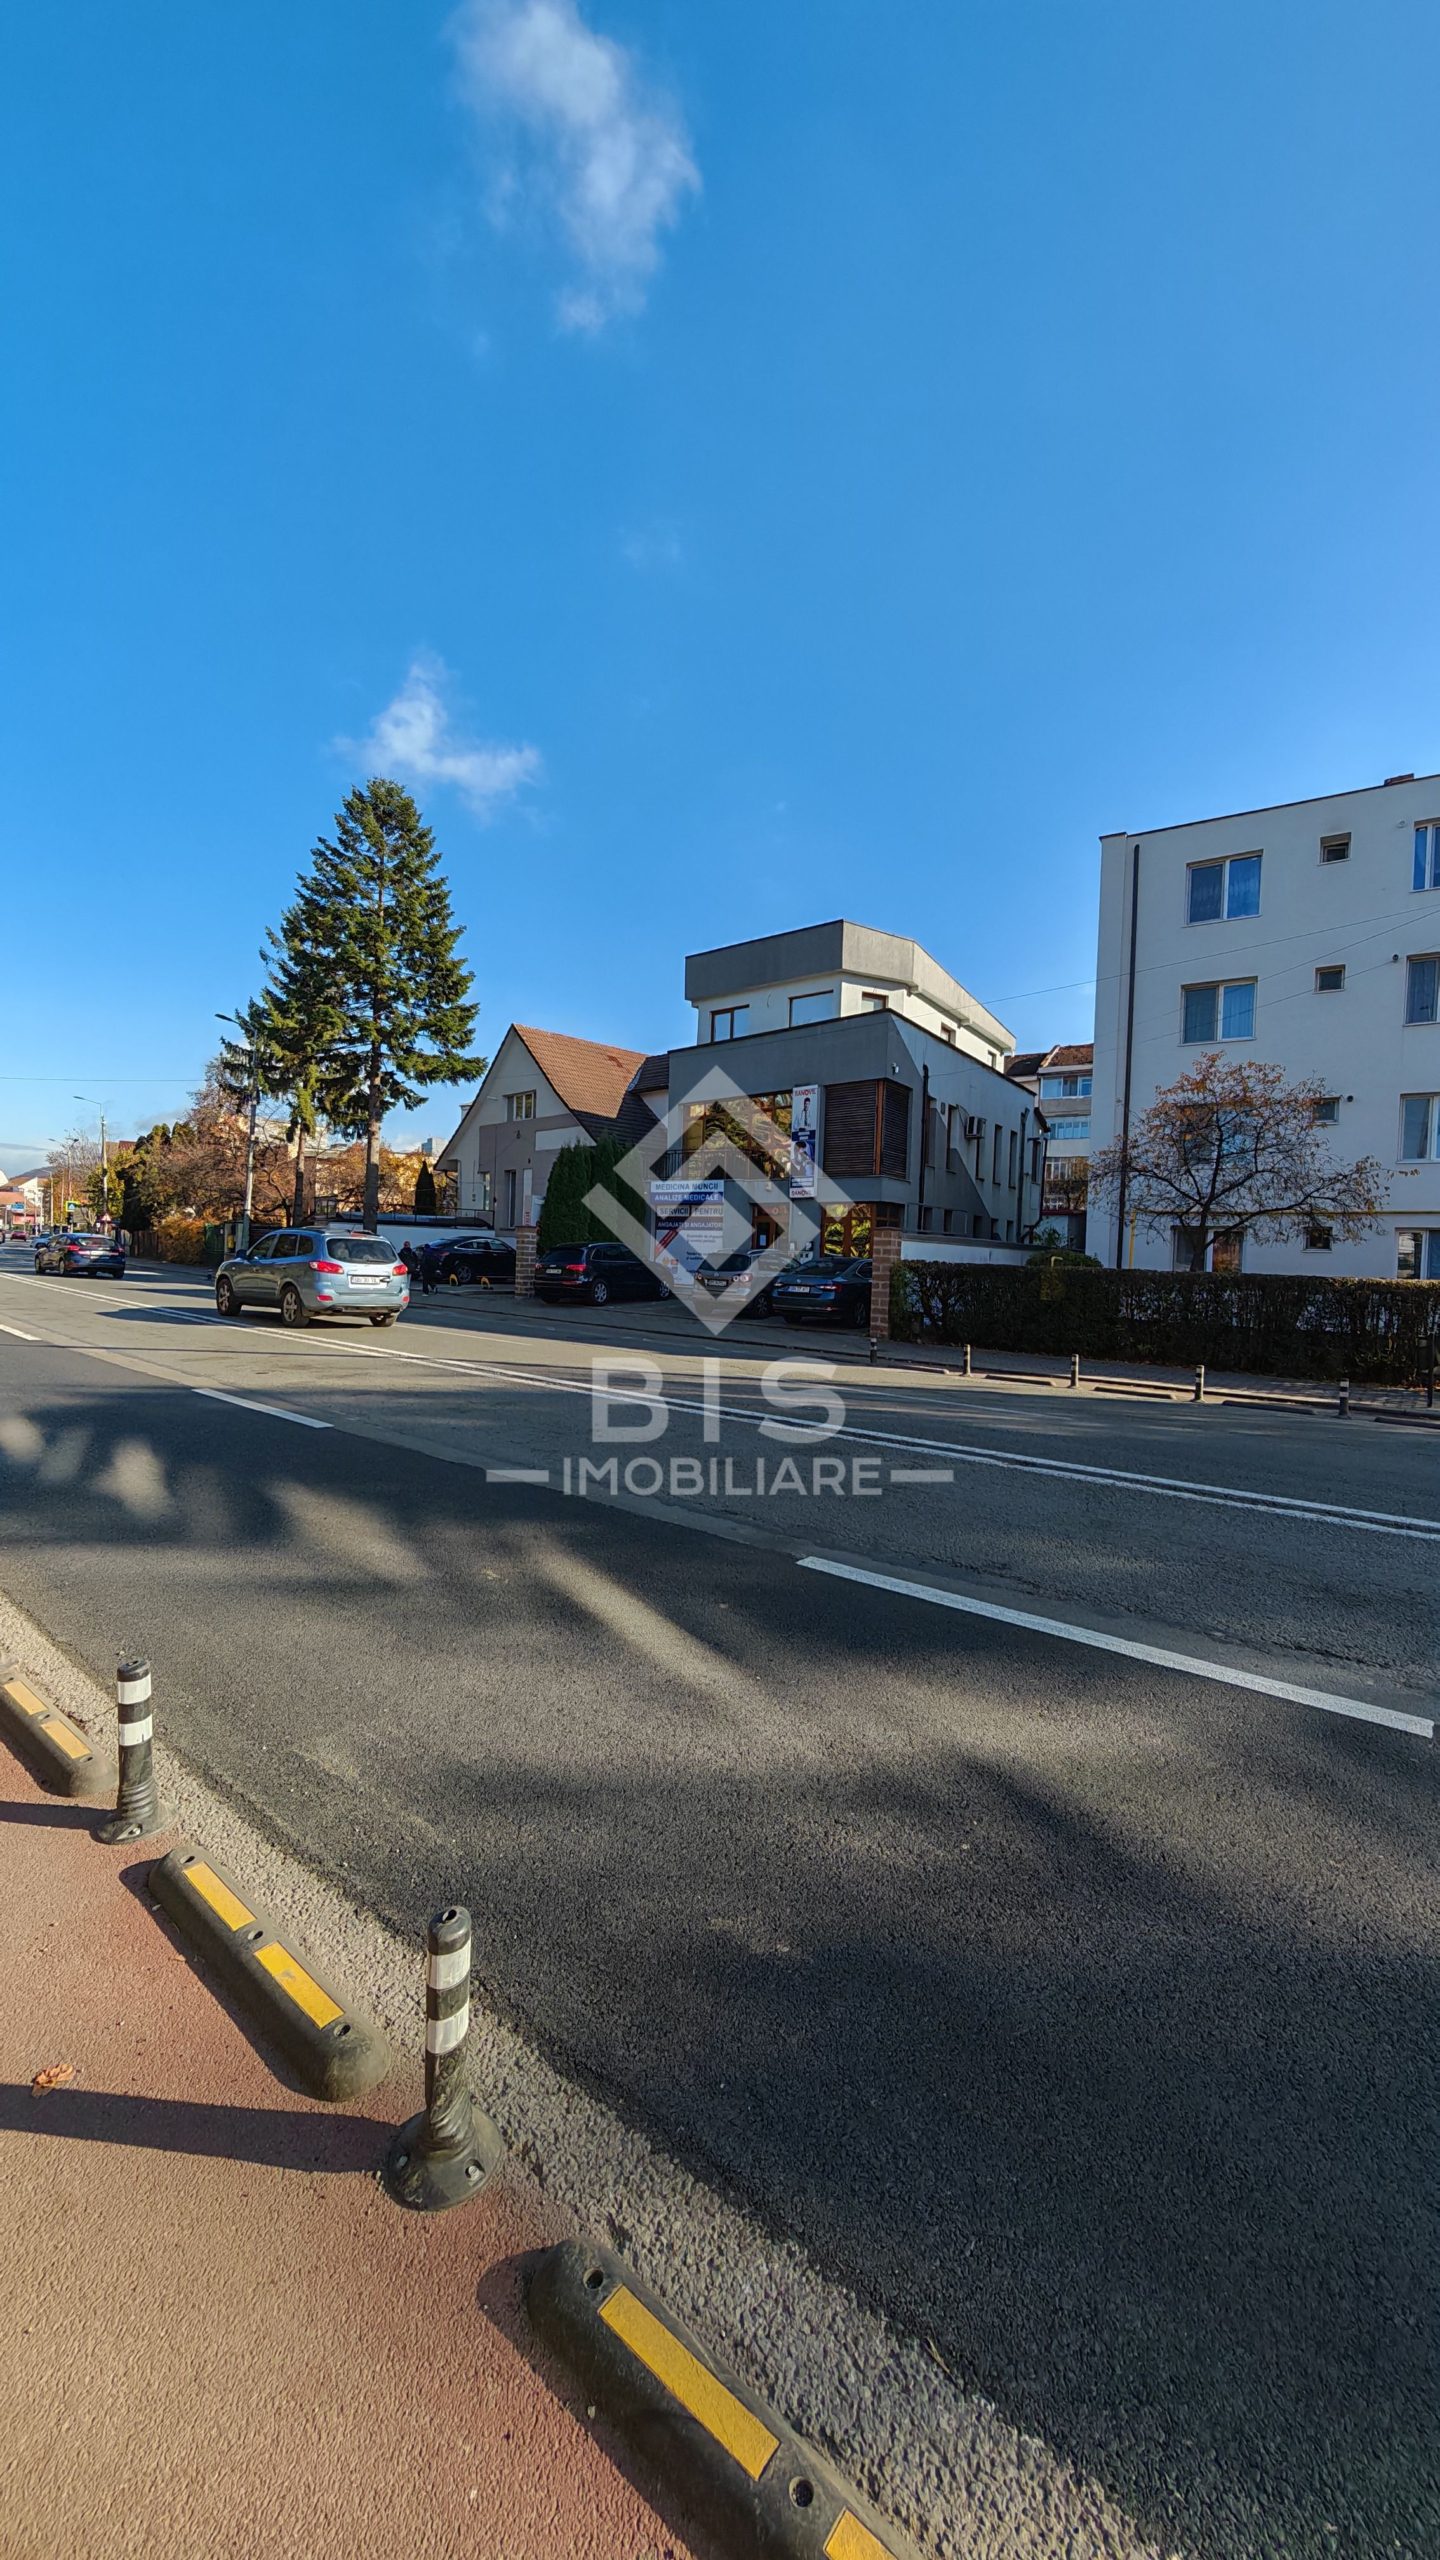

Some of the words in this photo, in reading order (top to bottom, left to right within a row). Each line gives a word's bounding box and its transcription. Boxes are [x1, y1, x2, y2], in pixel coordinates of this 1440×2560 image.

[655, 1183, 690, 1191] MEDICINA
[692, 1182, 719, 1190] MUNCII
[655, 1193, 681, 1201] ANALIZE
[683, 1193, 719, 1201] MEDICALE
[660, 1207, 689, 1216] SERVICII
[694, 1207, 723, 1216] PENTRU
